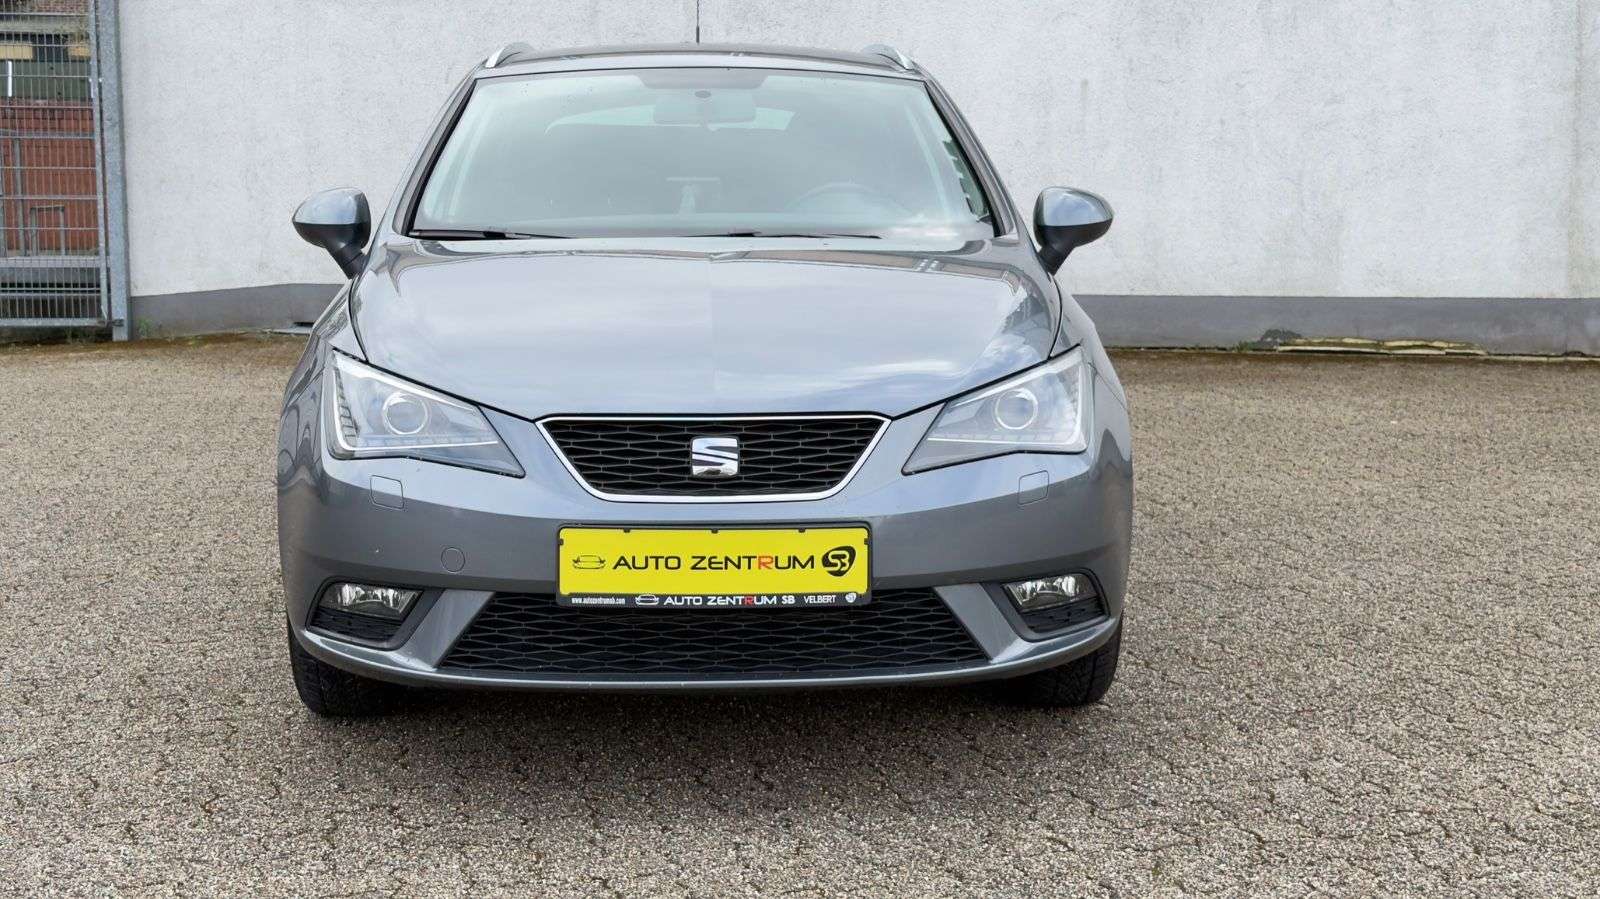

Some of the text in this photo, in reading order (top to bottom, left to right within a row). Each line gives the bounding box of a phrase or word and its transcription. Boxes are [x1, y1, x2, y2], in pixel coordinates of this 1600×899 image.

[612, 555, 682, 570] AUTO
[690, 555, 815, 570] ZENTRUM
[663, 596, 703, 606] AUTO
[706, 595, 777, 606] ZENTRUM
[781, 595, 796, 605] SB
[803, 594, 837, 604] VELBERT
